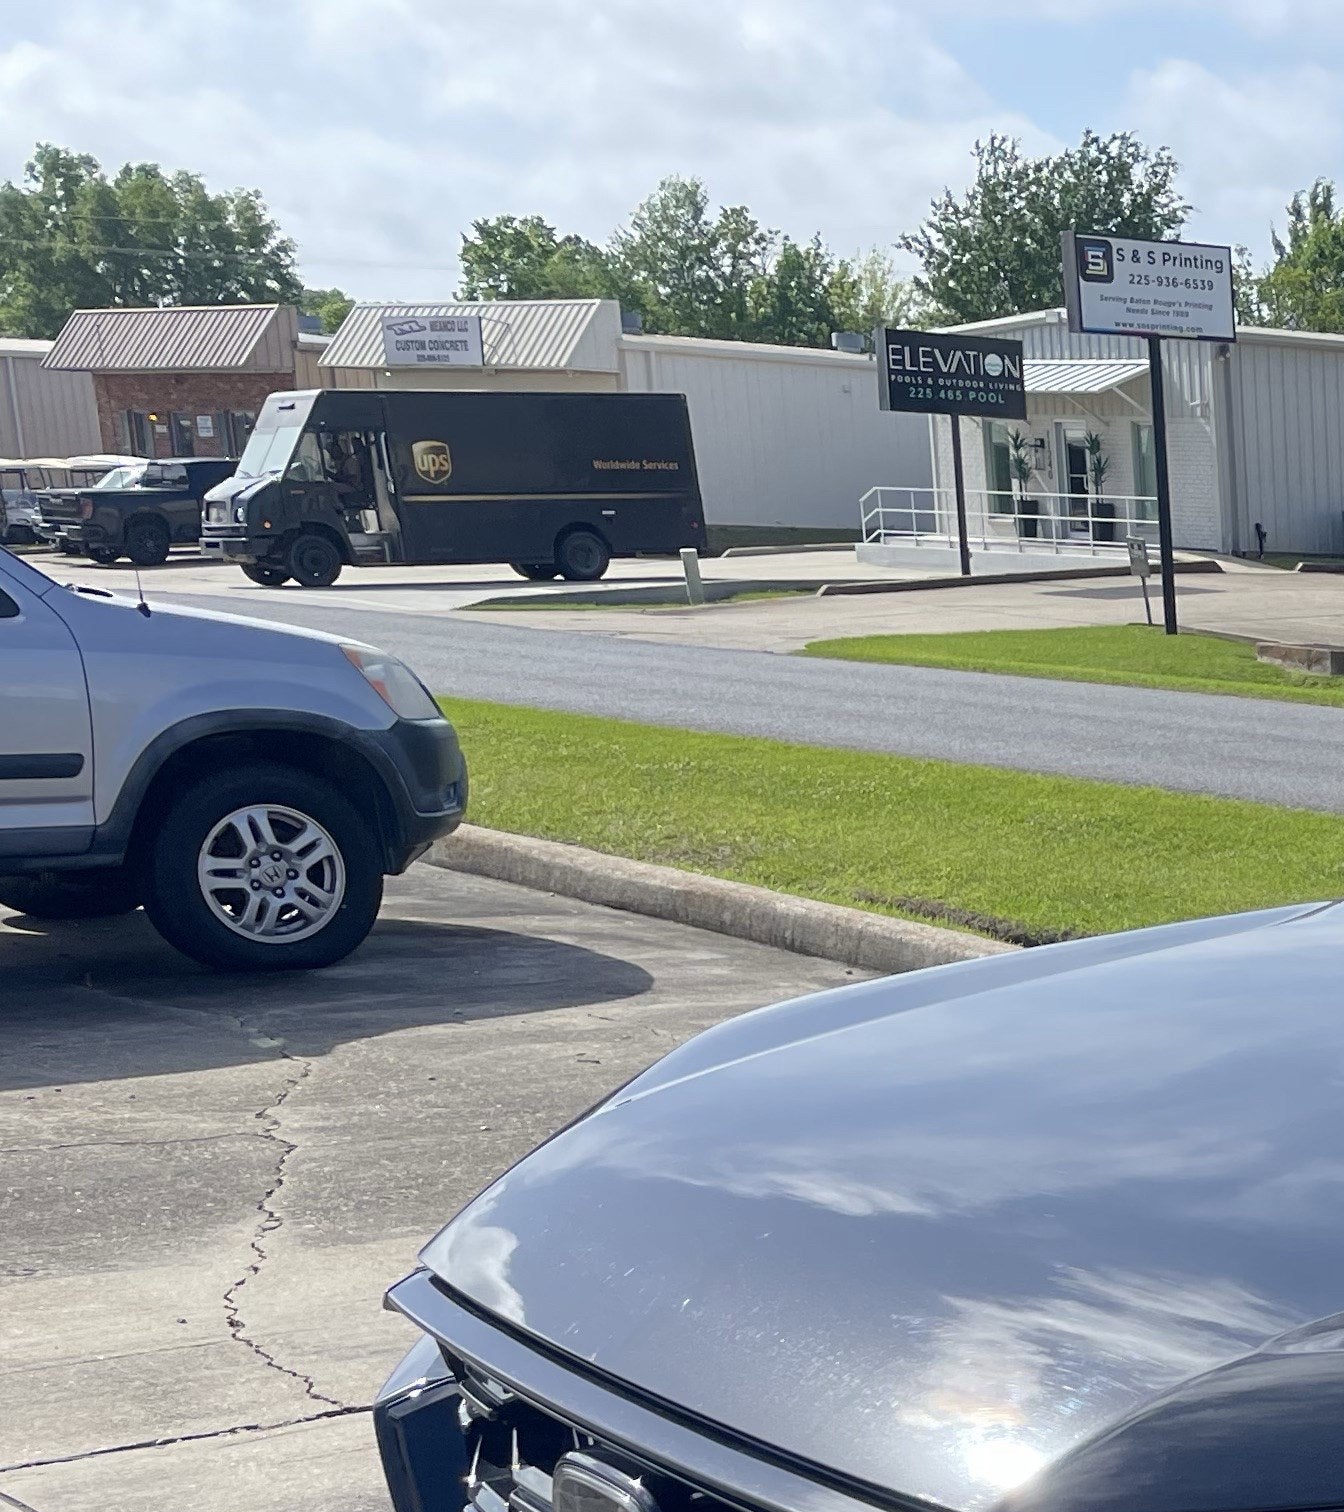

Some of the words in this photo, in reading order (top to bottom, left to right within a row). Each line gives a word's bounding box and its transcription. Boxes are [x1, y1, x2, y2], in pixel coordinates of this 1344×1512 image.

[1116, 247, 1126, 262] S
[1131, 249, 1141, 264] &
[1147, 250, 1156, 265] S
[1162, 252, 1224, 273] Printing
[1128, 274, 1214, 291] 225-936-6539
[1100, 294, 1128, 304] Serving
[395, 340, 427, 351] CUSTOM
[428, 340, 469, 351] CONCRETE
[888, 344, 1020, 378] ELEVATION
[890, 374, 922, 385] POOLS
[938, 378, 984, 388] OUTDOOR
[988, 382, 1022, 392] LIVING
[908, 387, 933, 399] 225
[968, 391, 1005, 404] POOL
[418, 453, 449, 478] ups
[592, 459, 640, 470] Worldwide
[642, 459, 679, 470] Services
